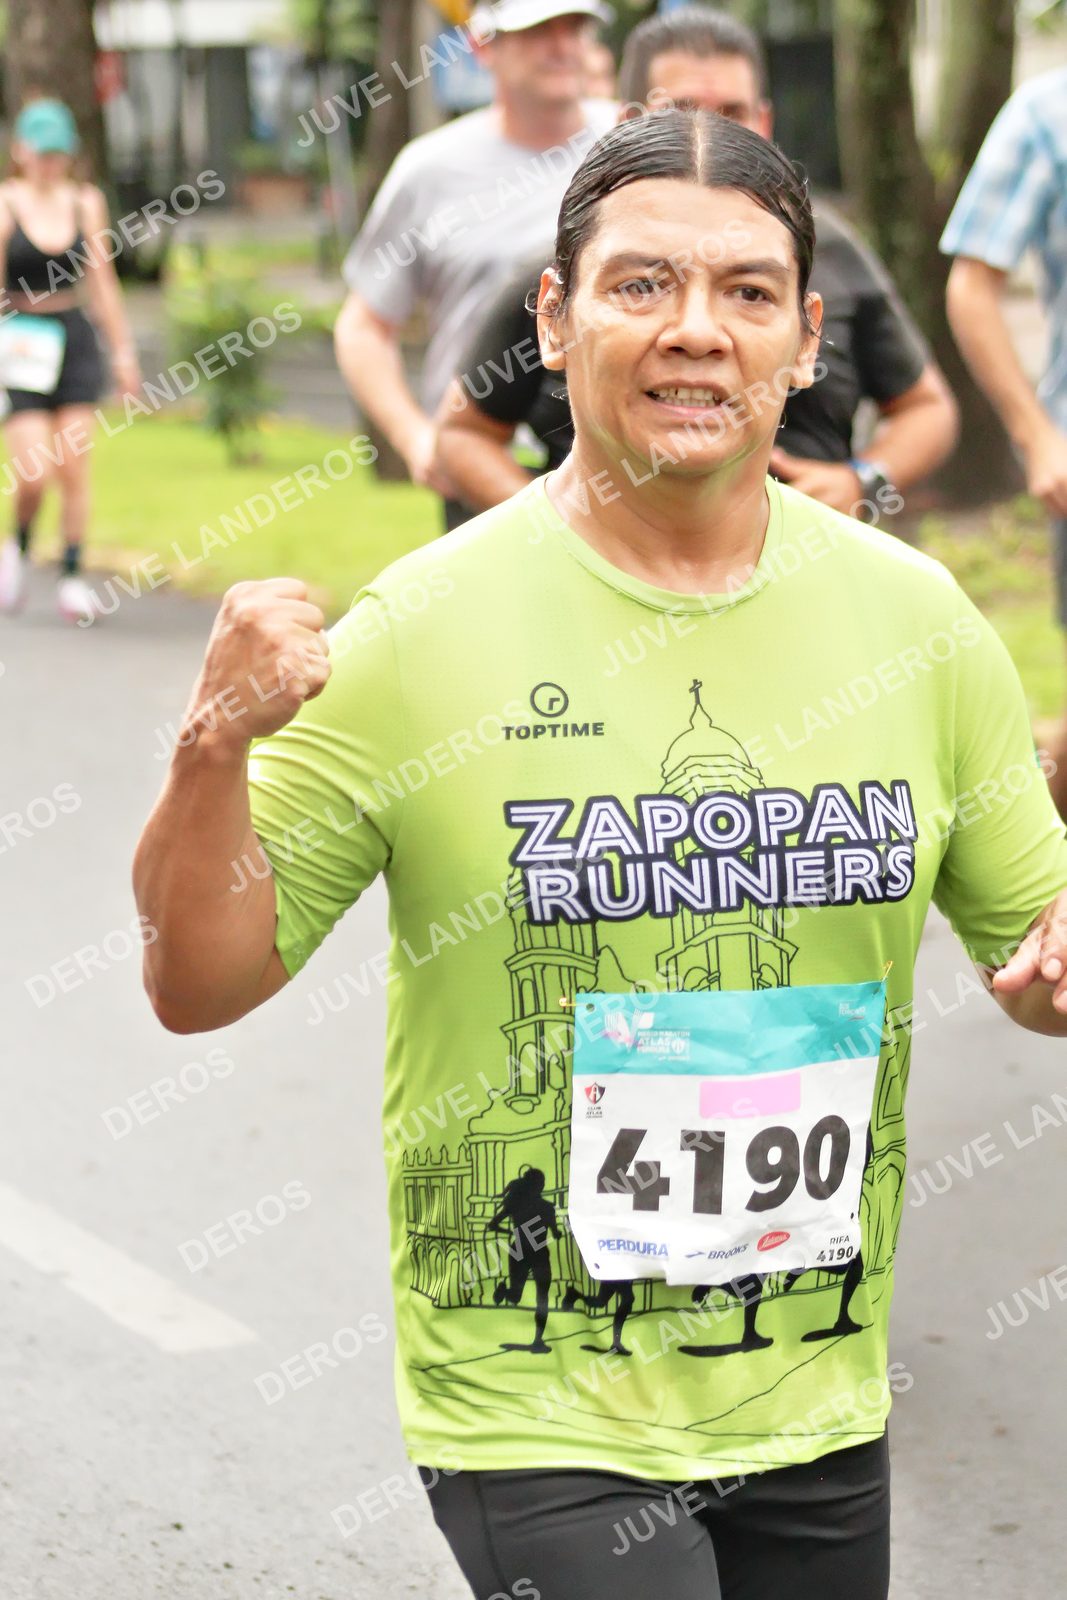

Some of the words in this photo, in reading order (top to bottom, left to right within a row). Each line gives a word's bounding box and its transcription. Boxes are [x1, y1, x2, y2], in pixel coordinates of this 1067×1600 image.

[502, 722, 605, 740] TOPTIME
[506, 783, 918, 864] ZAPOPAN
[522, 842, 915, 924] RUNNERS
[597, 1115, 850, 1215] 4190
[597, 1239, 669, 1257] PERDURA
[829, 1235, 851, 1246] RIFA
[707, 1243, 749, 1260] BROOKS
[816, 1245, 854, 1262] 4190
